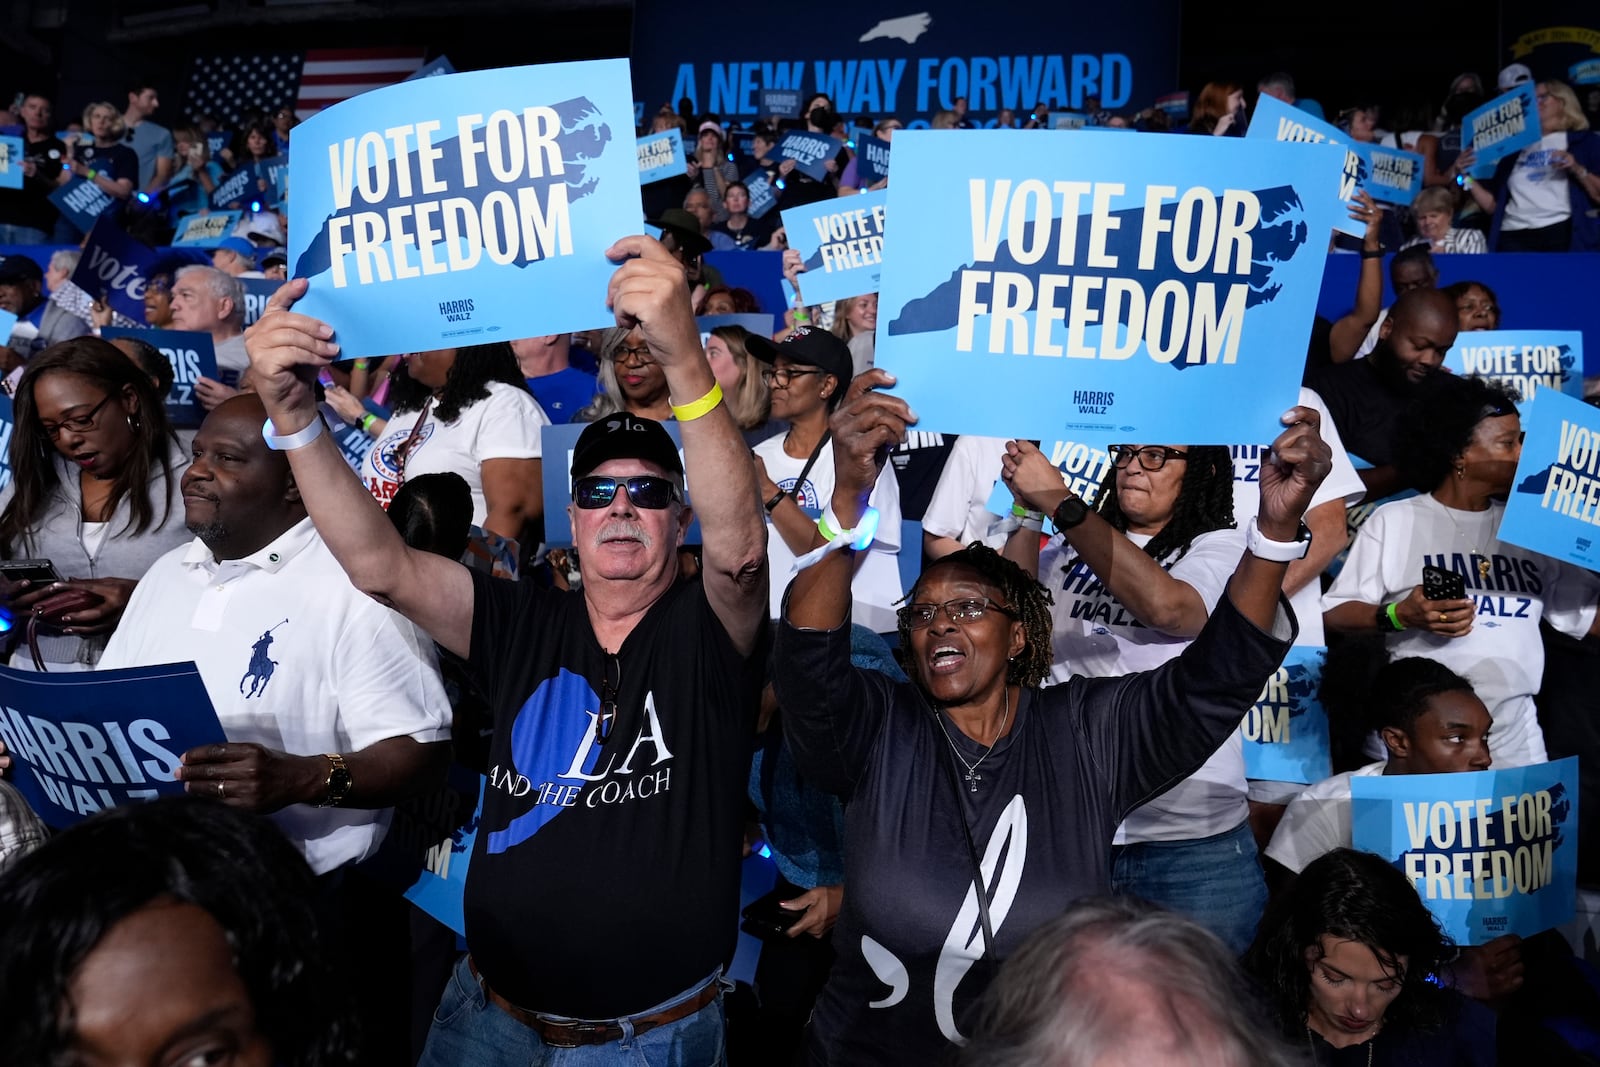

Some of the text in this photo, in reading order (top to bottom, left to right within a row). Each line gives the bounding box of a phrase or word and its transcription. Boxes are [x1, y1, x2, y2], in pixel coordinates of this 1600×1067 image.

[671, 63, 699, 115] A
[709, 62, 805, 115] NEW
[814, 59, 906, 114] WAY
[916, 53, 1133, 112] FORWARD
[1472, 96, 1523, 132] VOTE FOR
[1473, 114, 1526, 149] FREEDOM
[328, 106, 565, 209] VOTE FOR
[781, 135, 830, 159] HARRIS
[781, 147, 816, 166] WALZ
[328, 182, 574, 288] FREEDOM
[813, 208, 872, 244] VOTE
[969, 178, 1261, 276] VOTE FOR
[820, 235, 884, 273] FREED
[438, 298, 475, 315] HARRIS
[446, 312, 472, 323] WALZ
[956, 269, 1249, 366] FREEDOM
[1460, 344, 1562, 375] VOTE FOR
[1073, 390, 1115, 406] HARRIS
[1078, 405, 1107, 415] WALZ
[1557, 419, 1600, 477] VOT
[1232, 464, 1259, 482] LZ
[31, 767, 159, 816] WAL
[489, 764, 671, 808] AND THE COACH
[1403, 789, 1553, 850] VOTE FOR
[1404, 839, 1553, 900] FREEDOM
